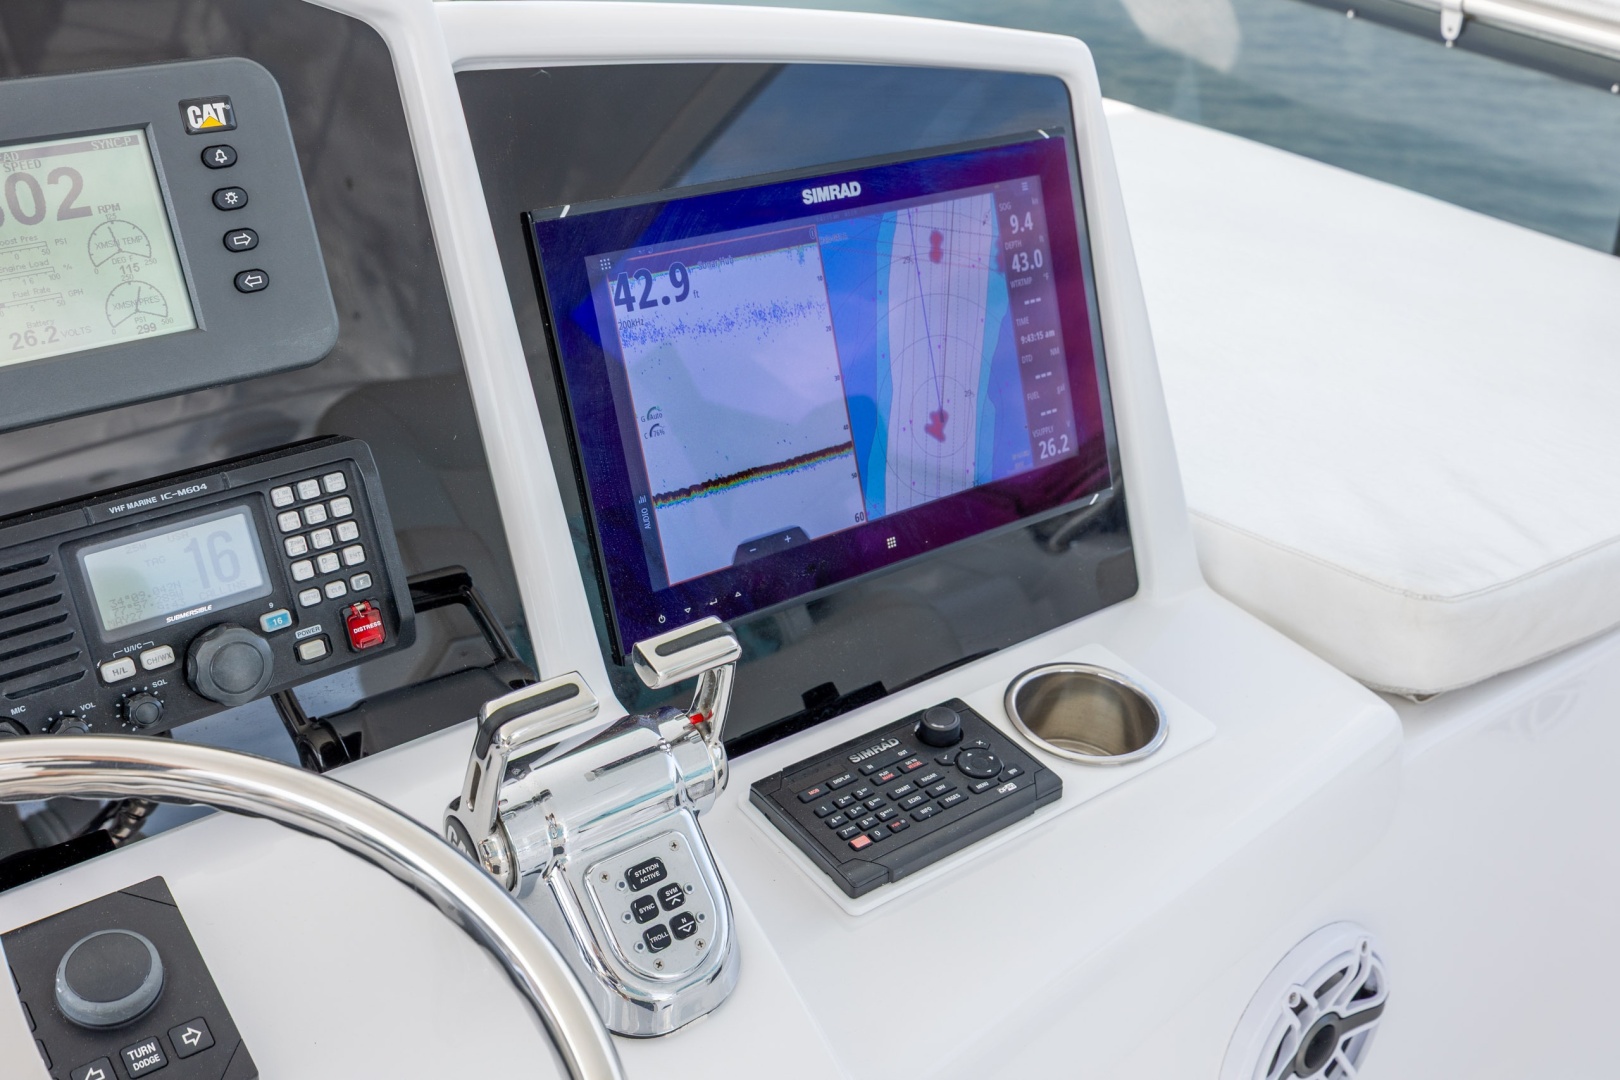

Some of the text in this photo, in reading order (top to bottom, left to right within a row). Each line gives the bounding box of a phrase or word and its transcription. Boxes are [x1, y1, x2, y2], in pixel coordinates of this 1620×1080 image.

[187, 102, 227, 129] CAT
[0, 150, 19, 163] AD
[2, 158, 42, 173] SPEED
[0, 166, 121, 227] 02 RPM
[802, 180, 862, 205] SIMRAD
[1009, 211, 1034, 235] 9.4
[54, 238, 68, 246] PSI
[1004, 239, 1022, 251] DEPTH
[29, 259, 50, 269] Load
[1011, 248, 1044, 273] 43.0
[119, 262, 141, 275] 115
[67, 288, 84, 298] GPH
[613, 261, 690, 313] 42.9
[1015, 316, 1030, 327] TIME
[135, 322, 158, 335] 299
[8, 325, 92, 351] 26.2 VOLTS
[1020, 329, 1056, 344] 9:43:15 am
[1026, 391, 1040, 401] FUEL
[1038, 434, 1070, 460] 26.2
[109, 483, 208, 514] VHF MARINE IC-M604
[641, 507, 652, 530] AUDIO
[854, 511, 865, 523] 60
[184, 529, 241, 590] 16
[166, 604, 213, 624] SUBMERSIBLE
[273, 617, 284, 626] 16
[353, 620, 382, 634] DISTRESS
[297, 626, 322, 638] POWER
[146, 651, 173, 666] CH/WX
[112, 667, 128, 677] H/L
[152, 679, 168, 688] SQL
[10, 705, 26, 716] MIC
[80, 702, 96, 712] VOL
[849, 737, 900, 764] SIMRAD
[832, 774, 851, 785] DISPLAY
[894, 784, 911, 794] CHART
[944, 793, 961, 803] PAGES
[634, 862, 660, 878] STATION
[640, 870, 661, 884] ACTIVE
[638, 902, 656, 914] SYNC
[649, 931, 669, 944] TROLL
[126, 1042, 157, 1061] TURN
[132, 1054, 161, 1071] DODGE
